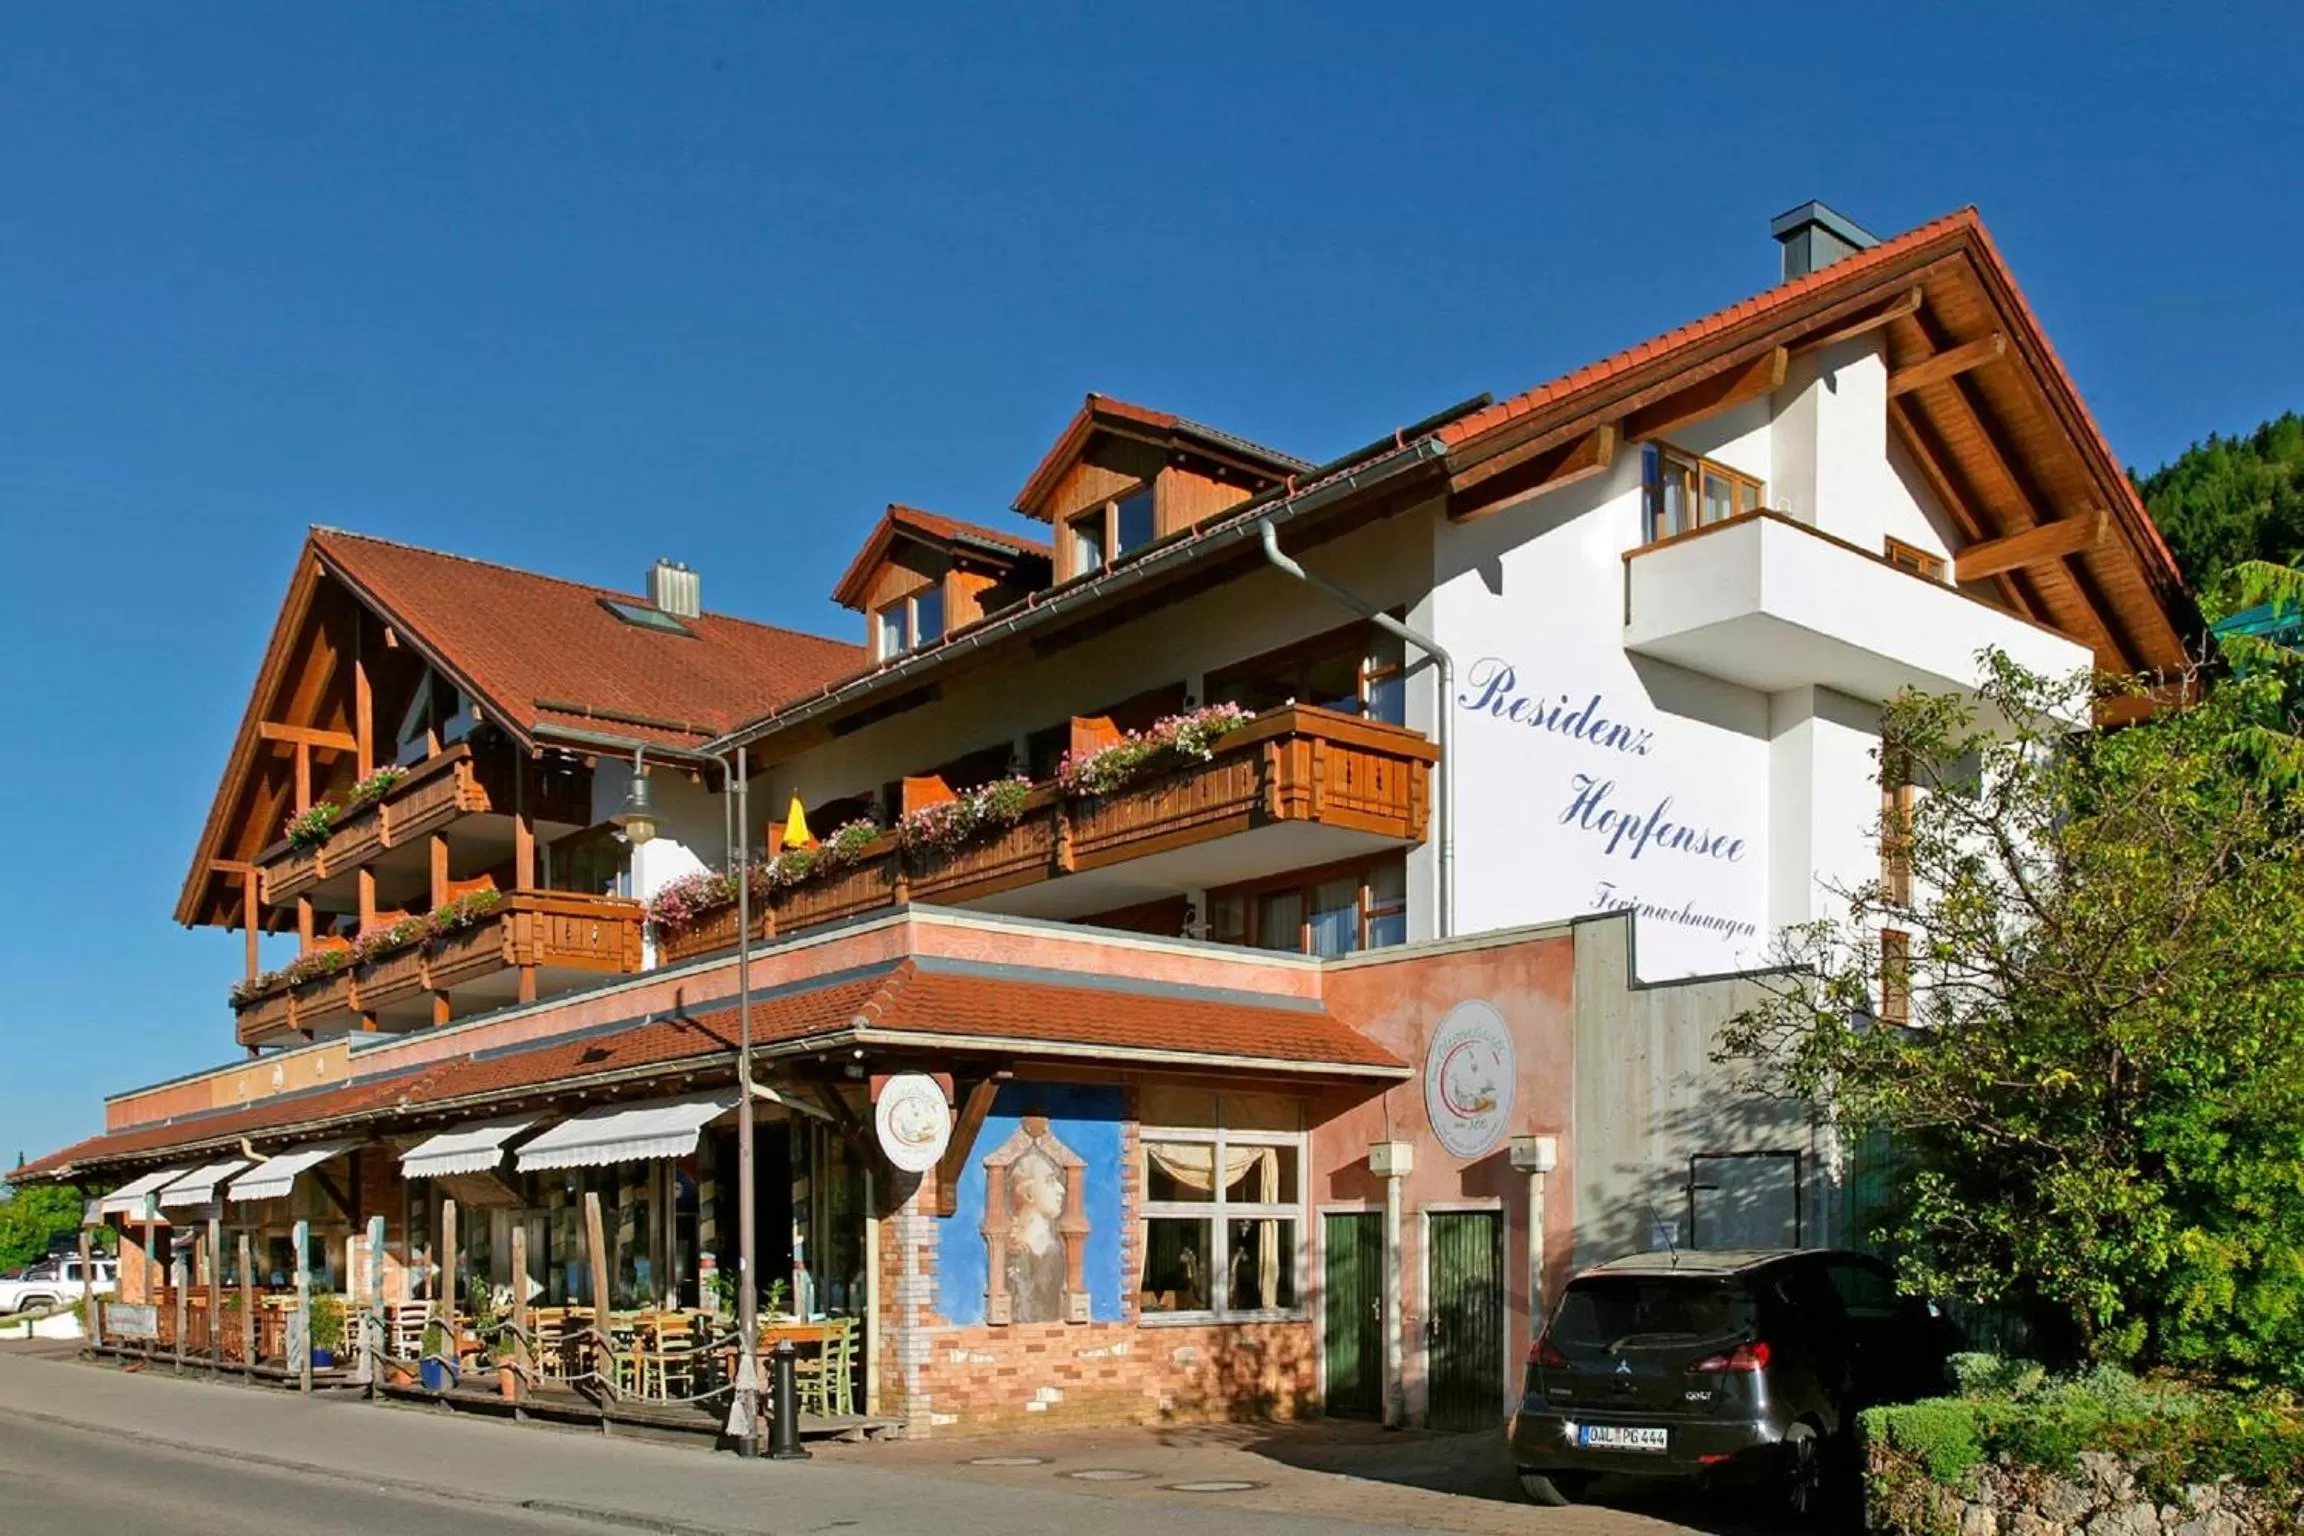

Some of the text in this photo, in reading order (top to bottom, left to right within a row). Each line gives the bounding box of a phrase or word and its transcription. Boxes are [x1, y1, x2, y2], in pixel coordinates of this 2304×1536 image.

[1458, 657, 1653, 755] Residenz
[1558, 773, 1746, 863] Hopfensee
[1641, 1430, 1665, 1446] 444
